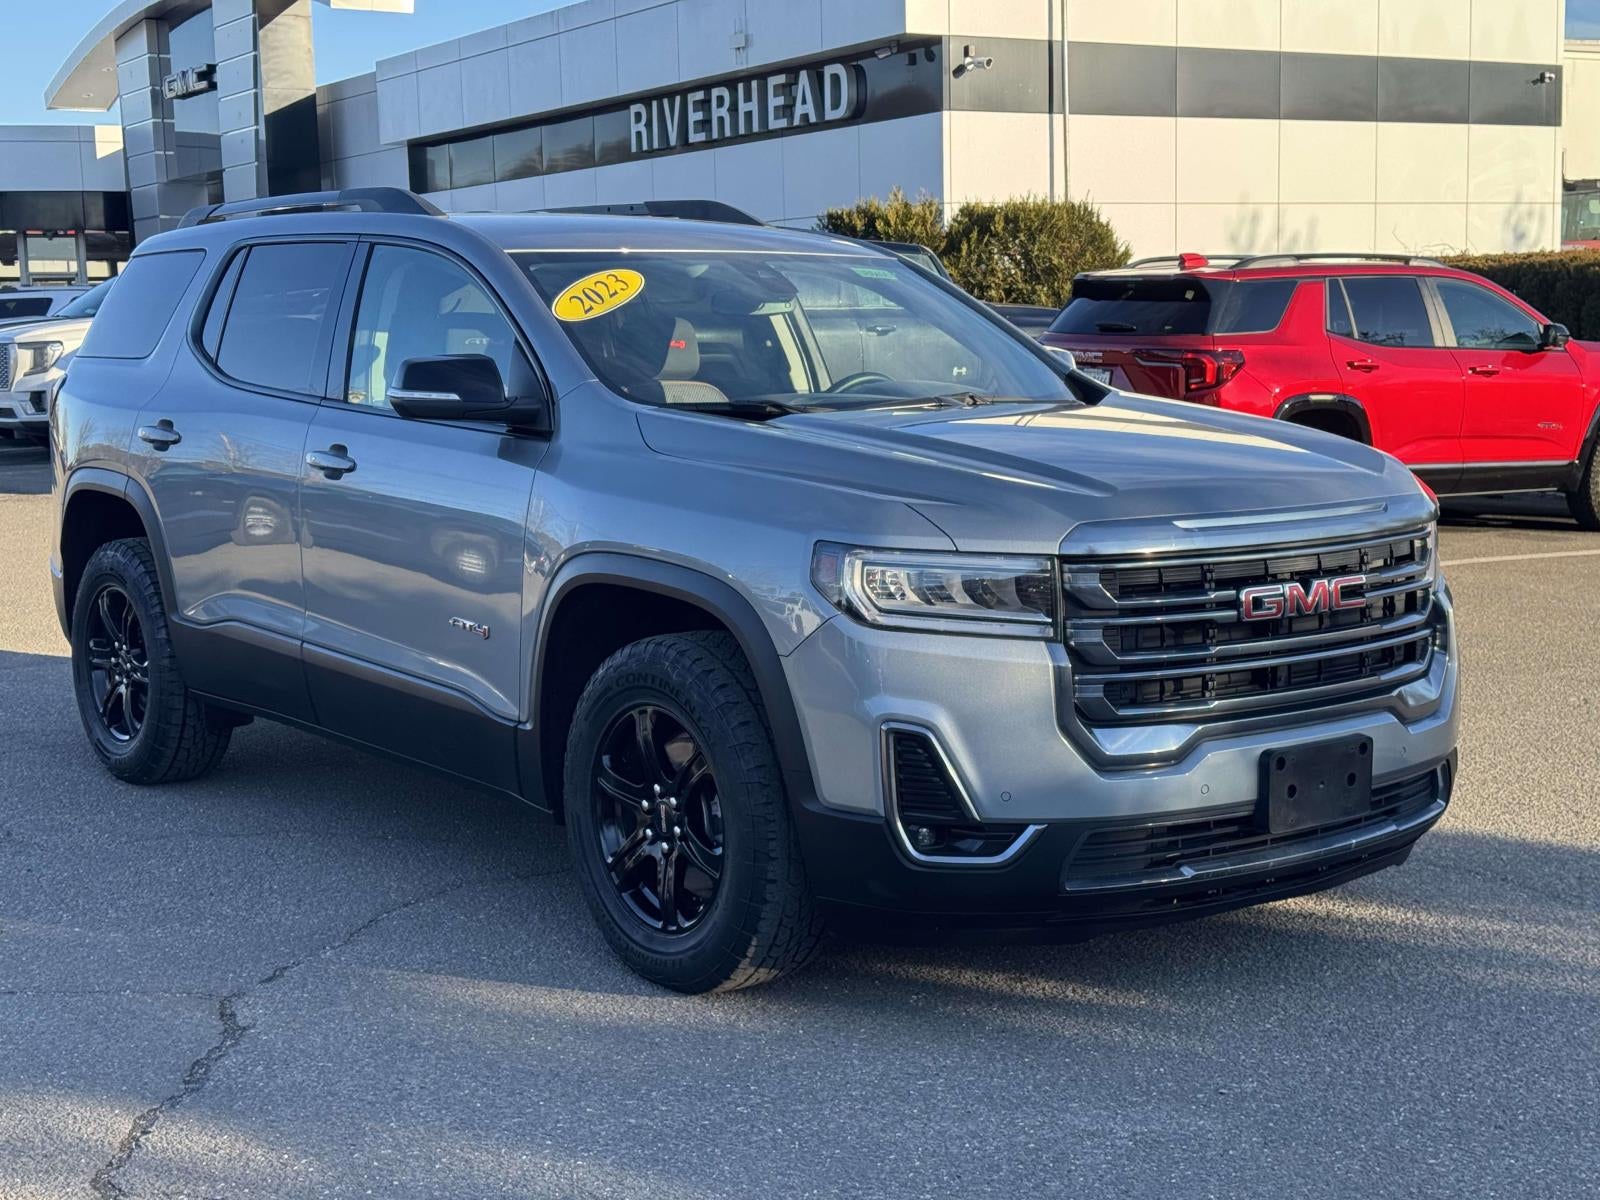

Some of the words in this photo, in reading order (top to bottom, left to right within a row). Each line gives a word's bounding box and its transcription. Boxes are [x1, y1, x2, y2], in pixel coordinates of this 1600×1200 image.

[163, 64, 210, 99] GMC
[630, 63, 849, 153] RIVERHEAD
[569, 274, 629, 315] 2023
[1240, 575, 1366, 621] GMC
[448, 616, 489, 640] AT4
